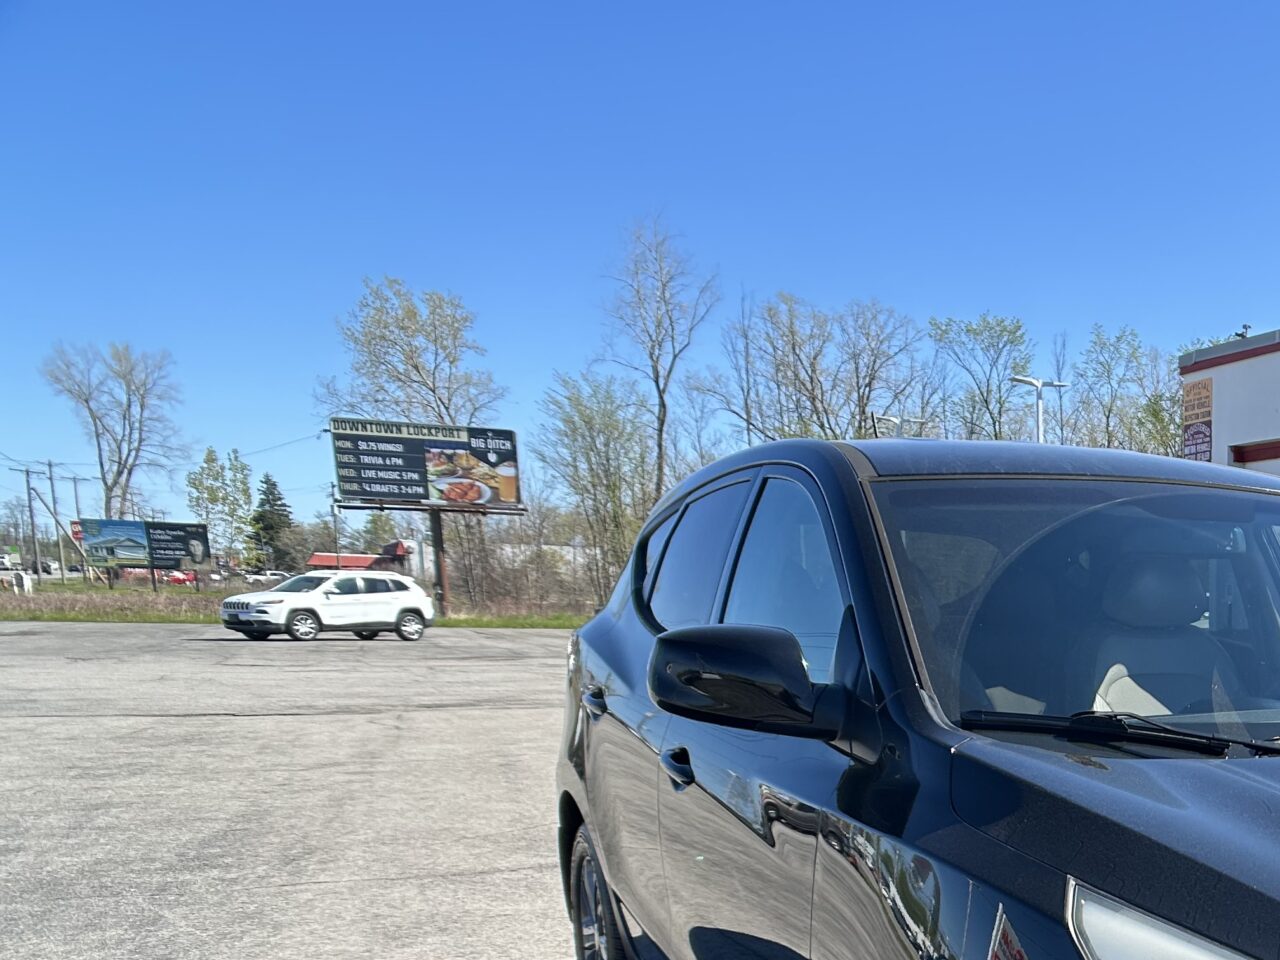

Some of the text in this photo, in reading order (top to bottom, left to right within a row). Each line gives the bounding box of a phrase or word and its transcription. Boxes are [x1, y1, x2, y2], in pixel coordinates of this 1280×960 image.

[332, 420, 461, 438] DOWNTOWN LOCKPORT
[470, 438, 512, 450] BIG DITCH
[361, 470, 377, 479] LIVE
